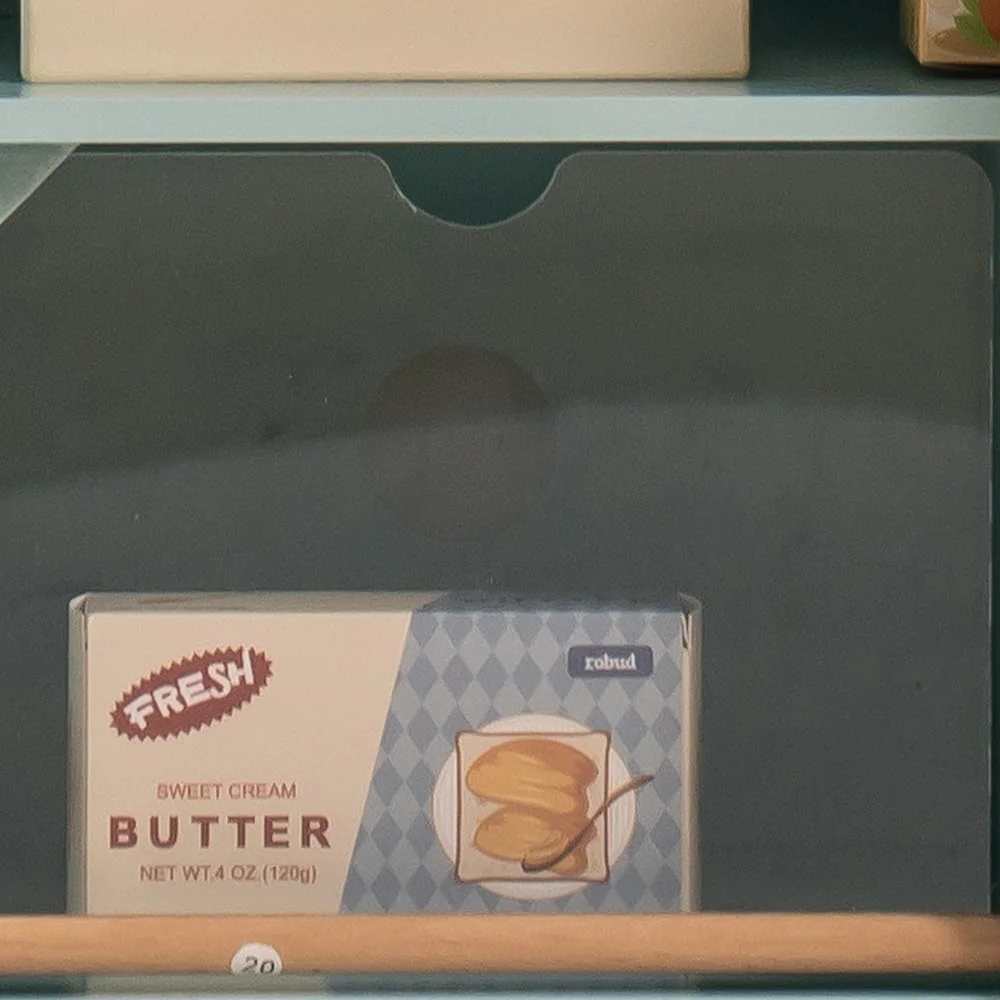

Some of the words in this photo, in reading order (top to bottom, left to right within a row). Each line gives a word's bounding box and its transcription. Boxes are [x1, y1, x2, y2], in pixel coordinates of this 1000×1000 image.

[584, 652, 636, 671] robud
[123, 647, 254, 731] FRESH
[156, 783, 223, 800] SWEET
[228, 783, 297, 800] CREAM
[109, 815, 331, 849] BUTTER
[140, 864, 176, 881] NET
